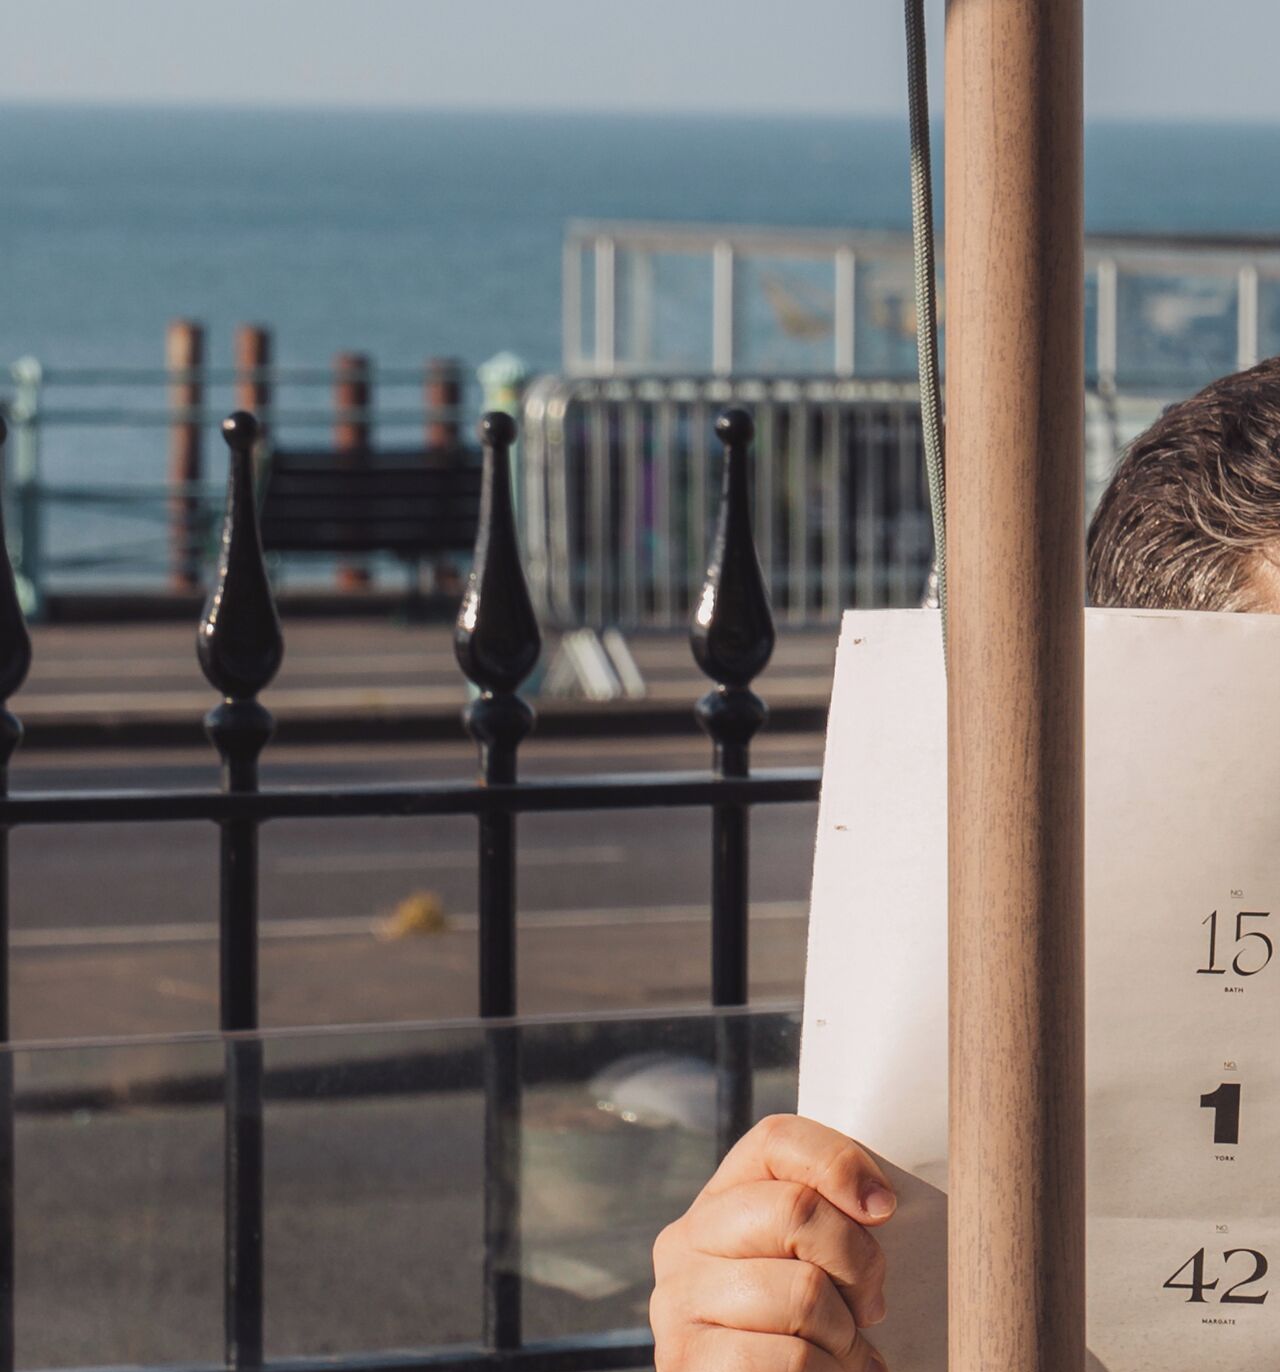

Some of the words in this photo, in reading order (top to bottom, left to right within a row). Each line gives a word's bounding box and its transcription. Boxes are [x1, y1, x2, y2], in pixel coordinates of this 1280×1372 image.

[1196, 910, 1273, 976] 15
[1200, 1083, 1241, 1144] 1
[1162, 1247, 1269, 1305] 42
